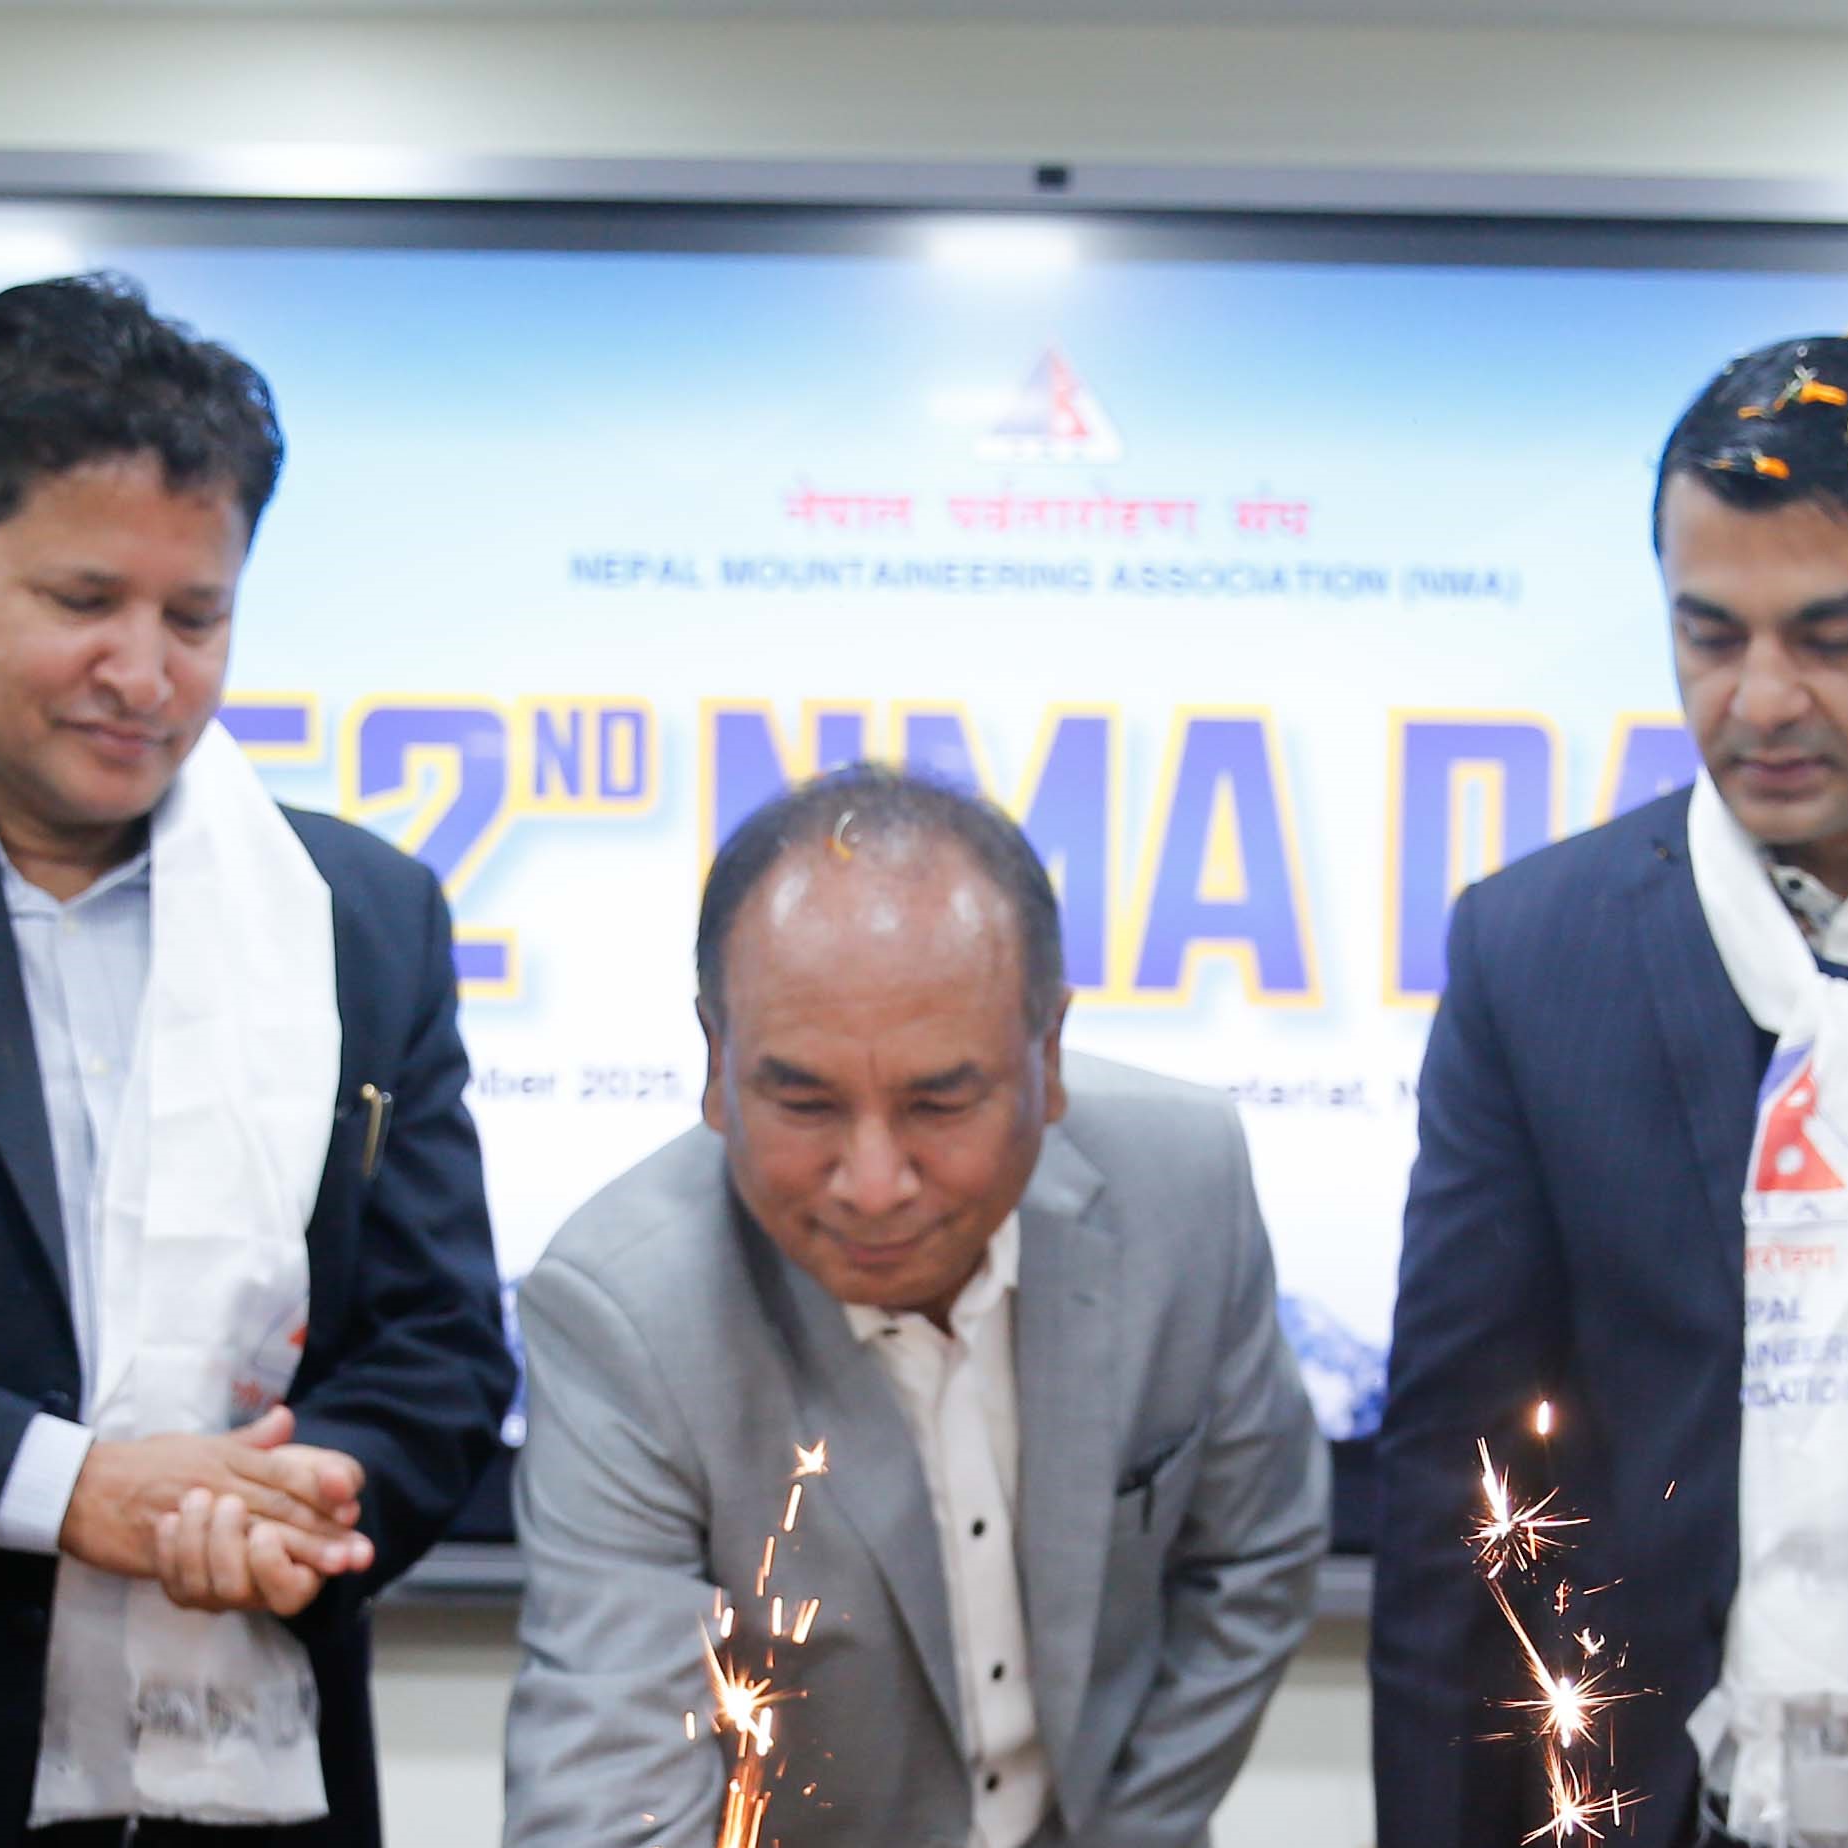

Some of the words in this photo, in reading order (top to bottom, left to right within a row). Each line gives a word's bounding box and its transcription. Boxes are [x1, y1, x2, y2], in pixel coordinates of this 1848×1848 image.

[569, 556, 699, 589] NEPAL
[720, 558, 1093, 595] MOUNTAINEERING
[1111, 564, 1390, 597] ASSOCIATION
[1401, 566, 1522, 604] (NMA)
[219, 693, 657, 1000] 2ND
